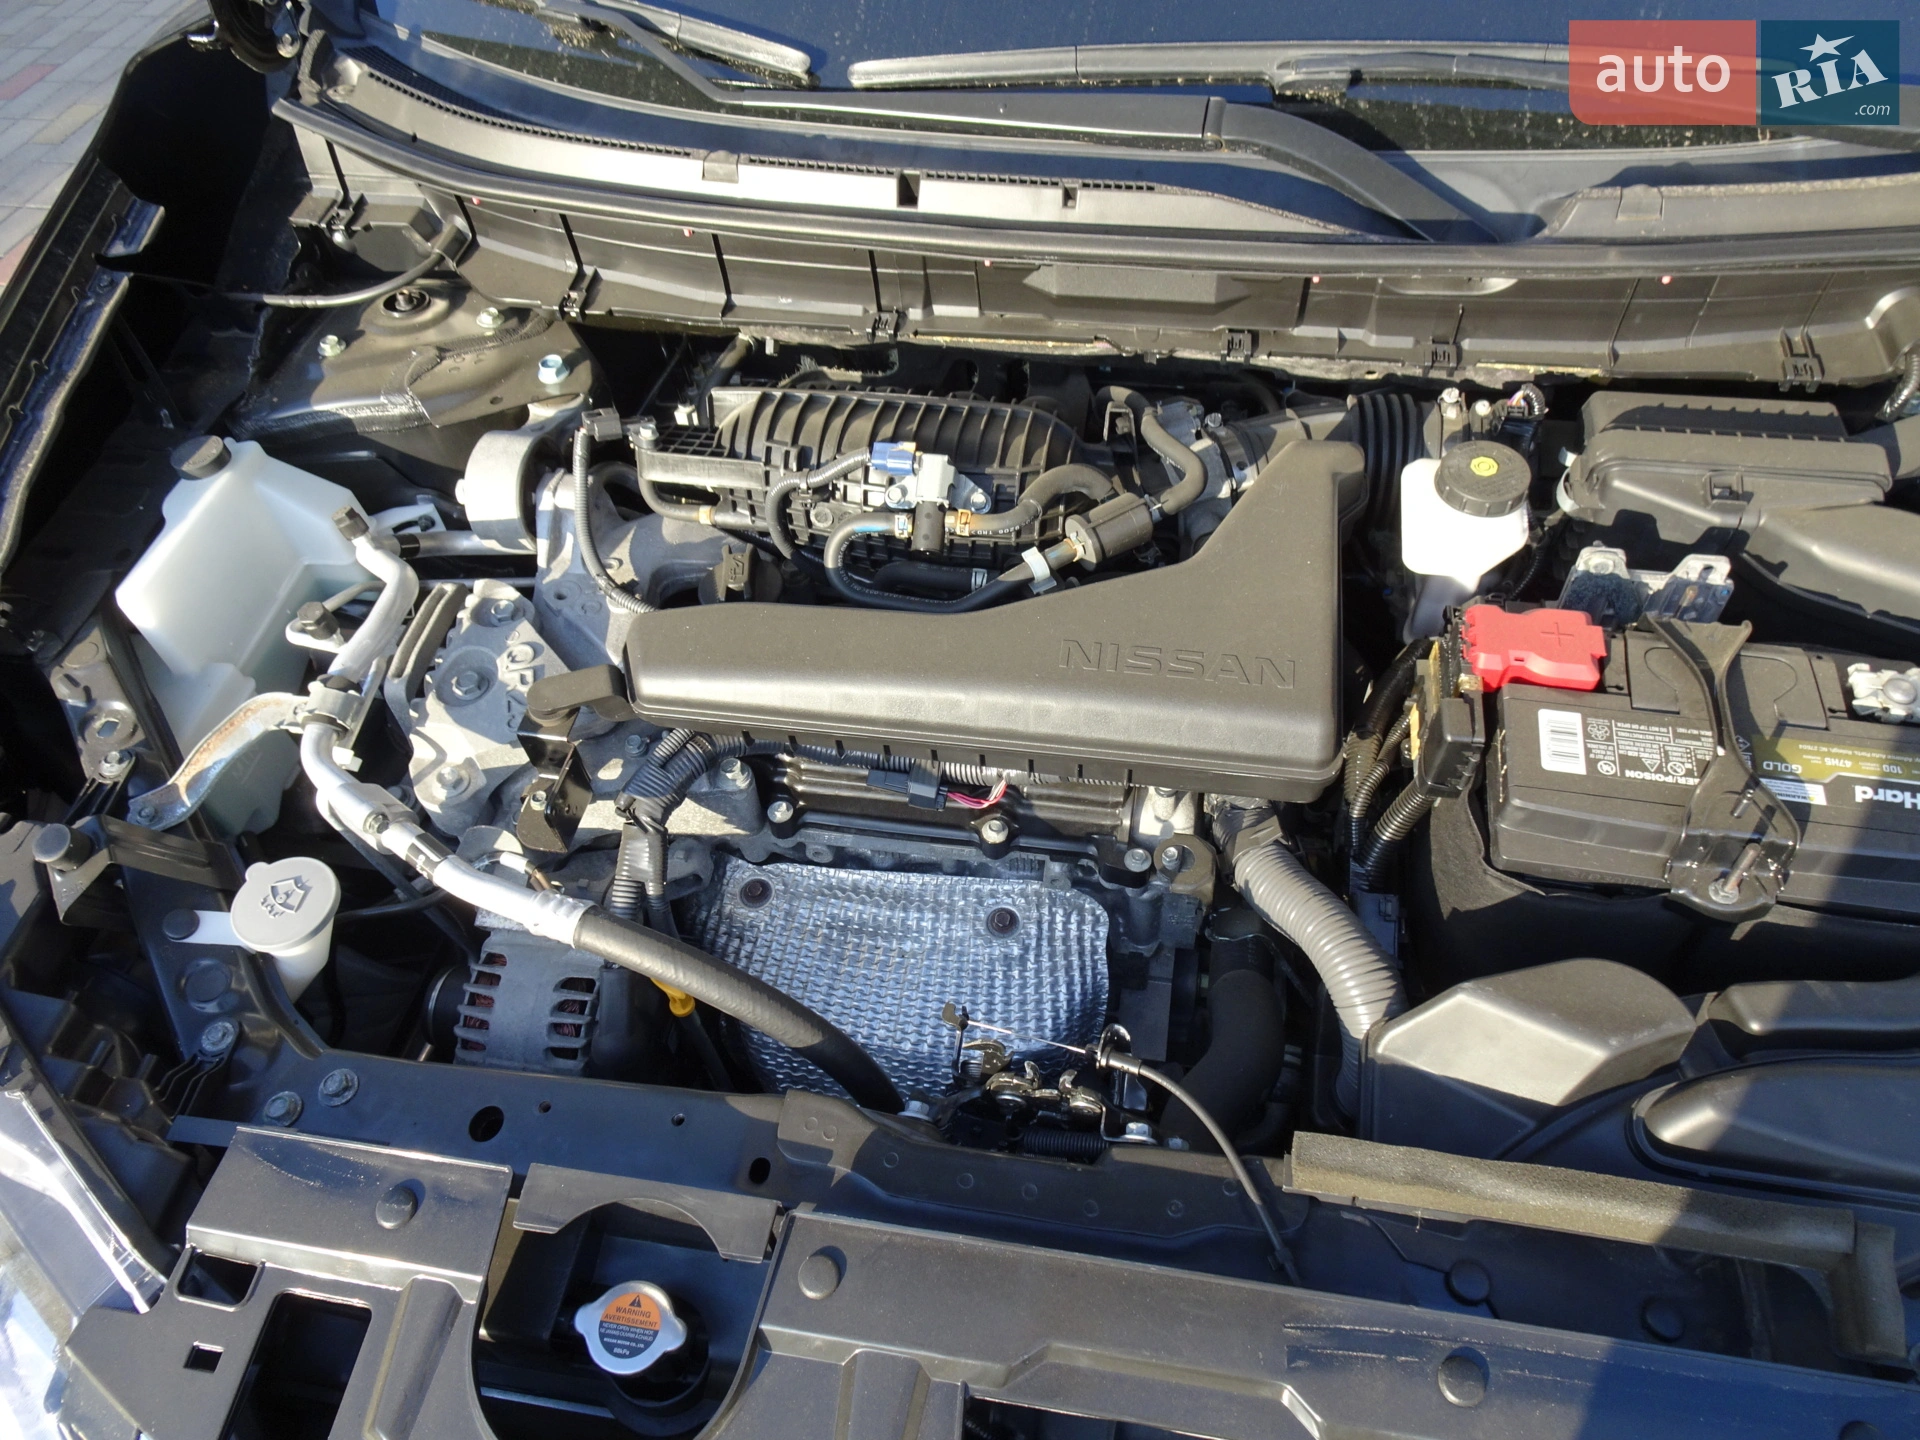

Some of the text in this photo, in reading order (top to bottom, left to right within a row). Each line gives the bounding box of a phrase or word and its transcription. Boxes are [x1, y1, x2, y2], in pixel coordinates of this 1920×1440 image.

[1059, 639, 1296, 689] NISSAN
[1763, 761, 1802, 773] GOLD
[1883, 764, 1903, 774] 100
[616, 1306, 651, 1318] WARNING
[604, 1313, 658, 1328] AVERTISSEMENT
